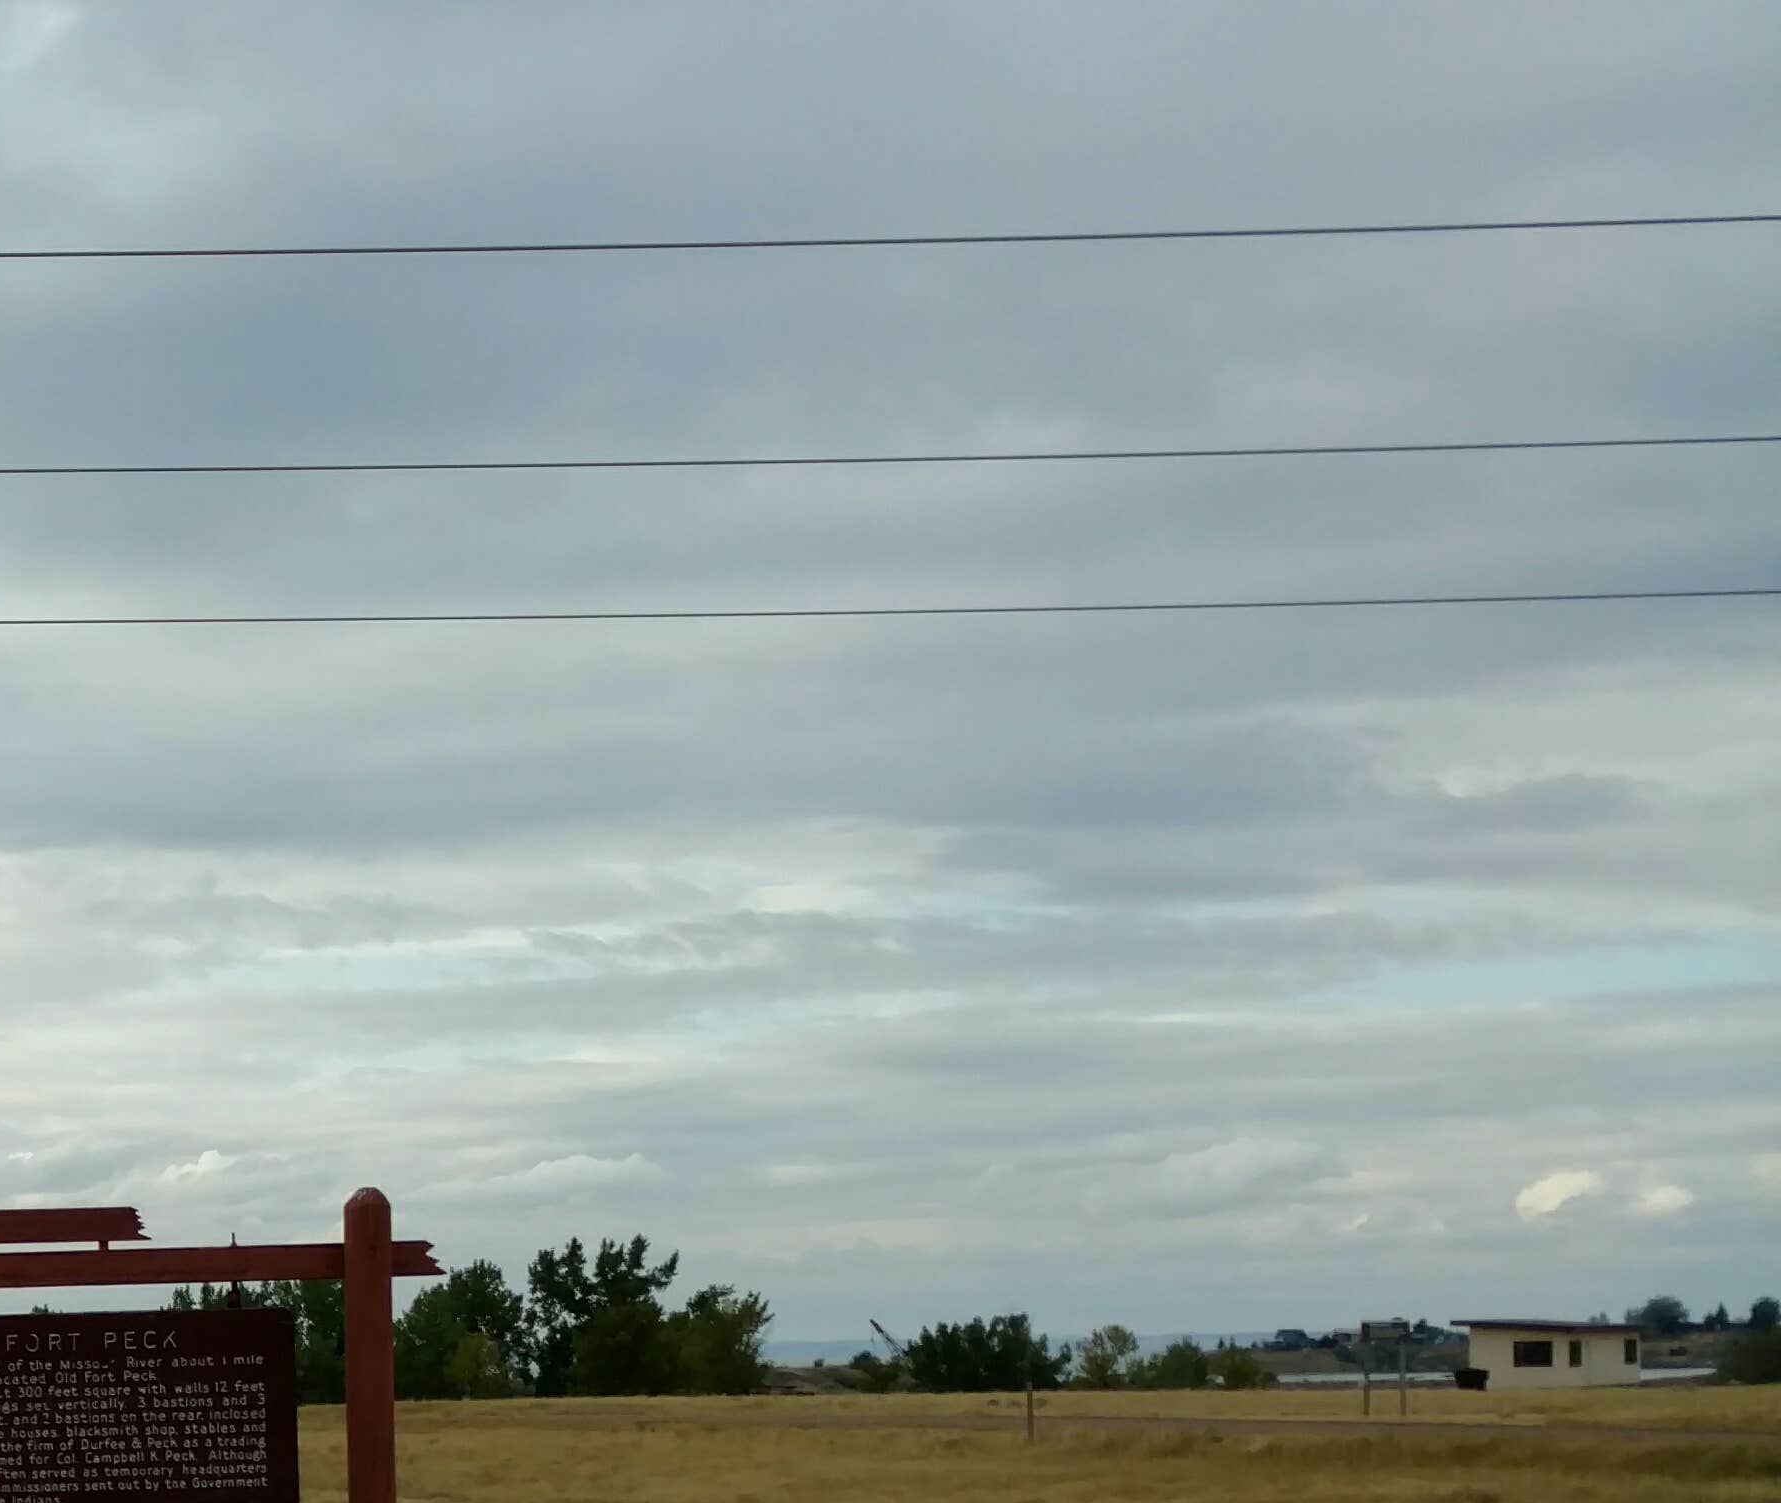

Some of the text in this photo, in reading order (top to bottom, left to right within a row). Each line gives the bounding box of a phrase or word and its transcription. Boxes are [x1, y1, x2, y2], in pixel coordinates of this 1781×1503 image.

[6, 1333, 80, 1352] FORT
[104, 1330, 177, 1350] PECK
[8, 1360, 24, 1372] of
[29, 1359, 53, 1371] the
[126, 1356, 162, 1368] River
[171, 1356, 214, 1367] about
[233, 1354, 264, 1365] mile
[55, 1372, 77, 1383] Old
[85, 1371, 116, 1382] Fort
[48, 1385, 79, 1396] feet
[84, 1386, 131, 1398] square
[138, 1384, 166, 1394] with
[175, 1382, 209, 1394] walls
[234, 1381, 266, 1391] feet
[154, 1396, 213, 1407] bastions
[222, 1395, 247, 1405] and
[13, 1413, 38, 1424] and
[56, 1412, 115, 1423] bastions
[121, 1412, 136, 1421] on
[143, 1410, 166, 1421] the
[66, 1424, 139, 1436] blacksmith
[184, 1422, 236, 1434] stables
[243, 1421, 266, 1432] and
[0, 1441, 22, 1452] the
[27, 1440, 53, 1451] firm
[60, 1439, 74, 1451] of
[81, 1438, 126, 1450] Durfee
[148, 1437, 179, 1448] Peck
[183, 1437, 198, 1447] as
[218, 1435, 266, 1449] trading
[29, 1454, 50, 1464] for
[85, 1452, 144, 1464] Campbell
[208, 1449, 267, 1462] Although
[32, 1469, 75, 1479] served
[83, 1467, 98, 1477] as
[105, 1464, 174, 1477] temporary
[182, 1463, 267, 1477] headquarters
[84, 1481, 113, 1491] sent
[118, 1480, 140, 1490] out
[145, 1478, 159, 1491] by
[192, 1477, 268, 1488] Government
